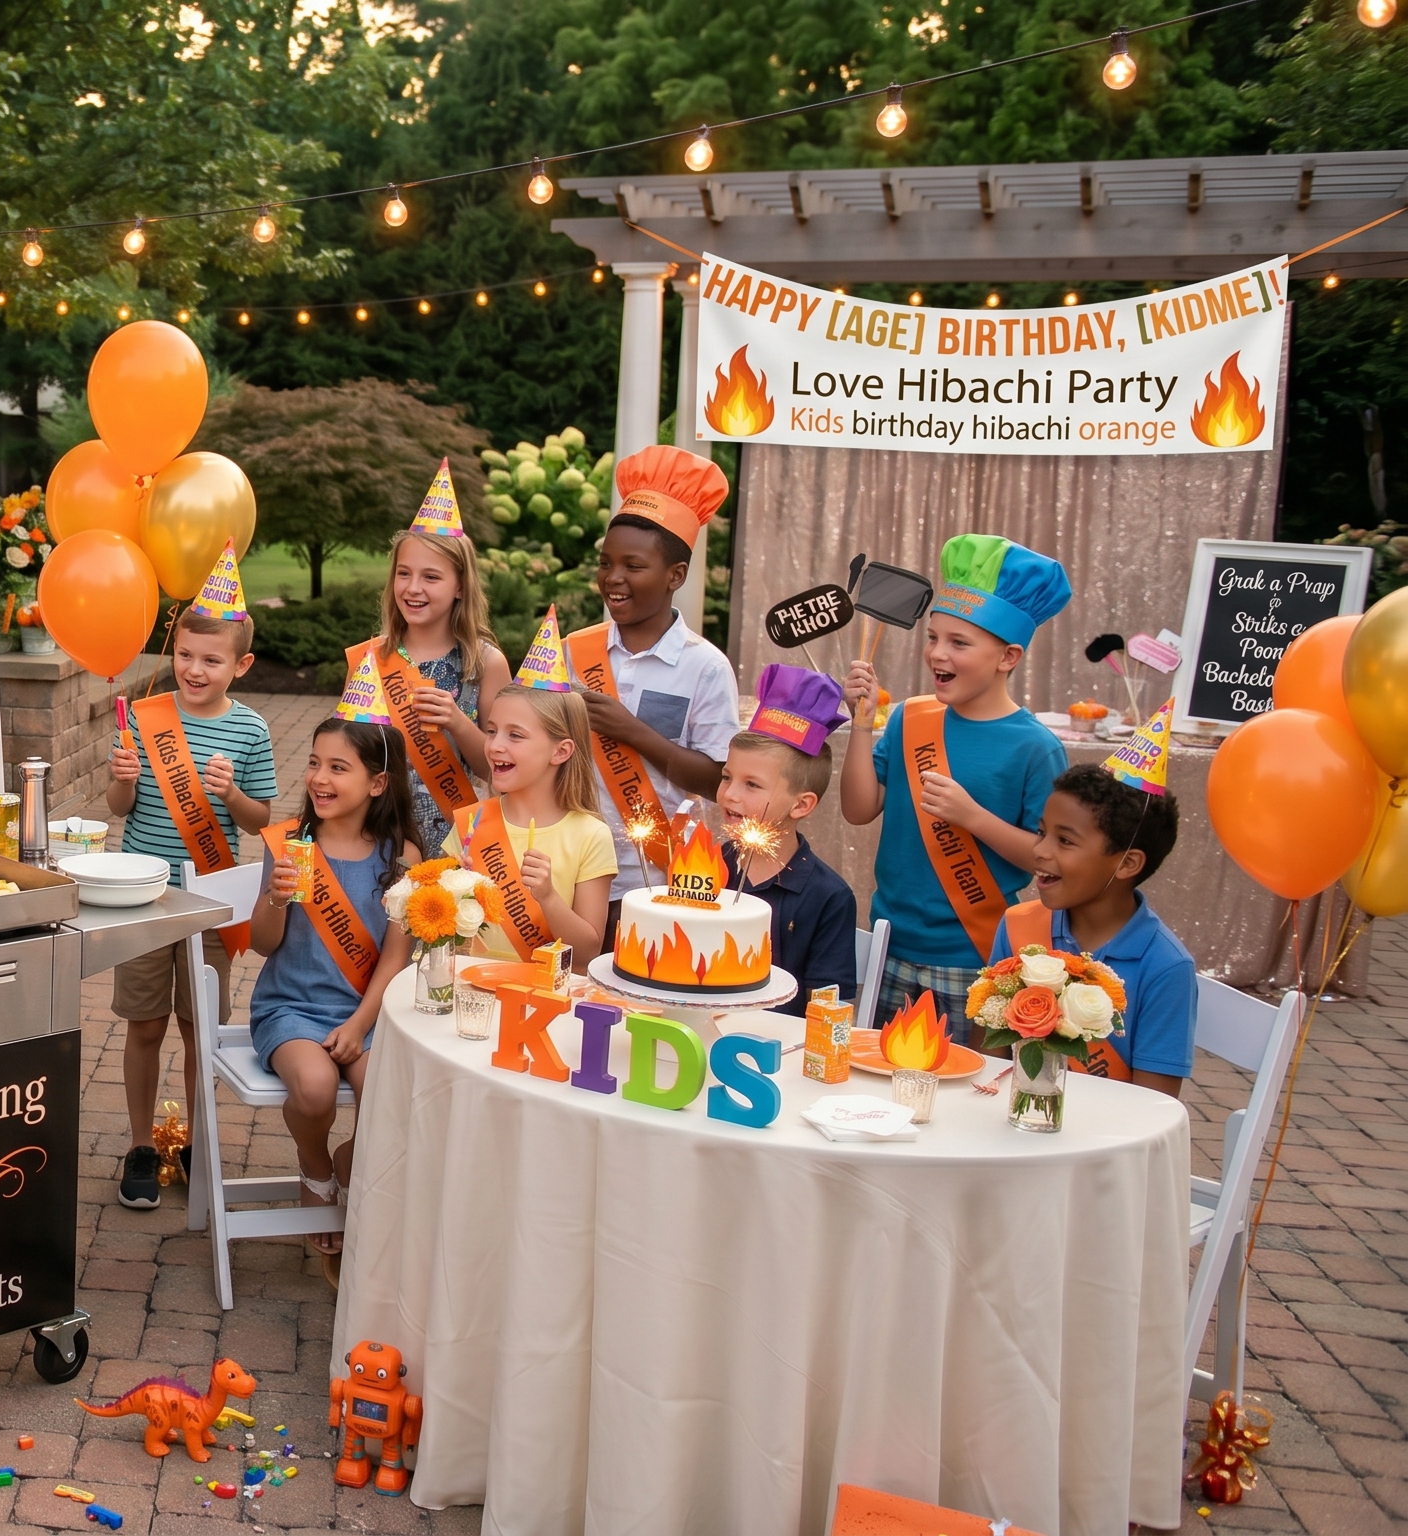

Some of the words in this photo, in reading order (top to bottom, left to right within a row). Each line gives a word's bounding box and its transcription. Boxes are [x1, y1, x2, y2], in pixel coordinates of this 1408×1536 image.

[703, 263, 821, 332] HAPPY
[825, 300, 926, 355] [AGE]
[937, 309, 1125, 356] BIRTHDAY,
[1137, 269, 1285, 345] [KIDME]!
[791, 362, 884, 400] Love
[897, 367, 1054, 404] Hibachi
[1068, 369, 1178, 412] Party
[790, 407, 844, 435] Kids
[852, 410, 964, 445] birthday
[973, 415, 1071, 440] hibachi
[1078, 418, 1176, 446] orange
[153, 729, 179, 765] Kids
[672, 874, 713, 891] KIDS
[491, 983, 781, 1128] KIDS
